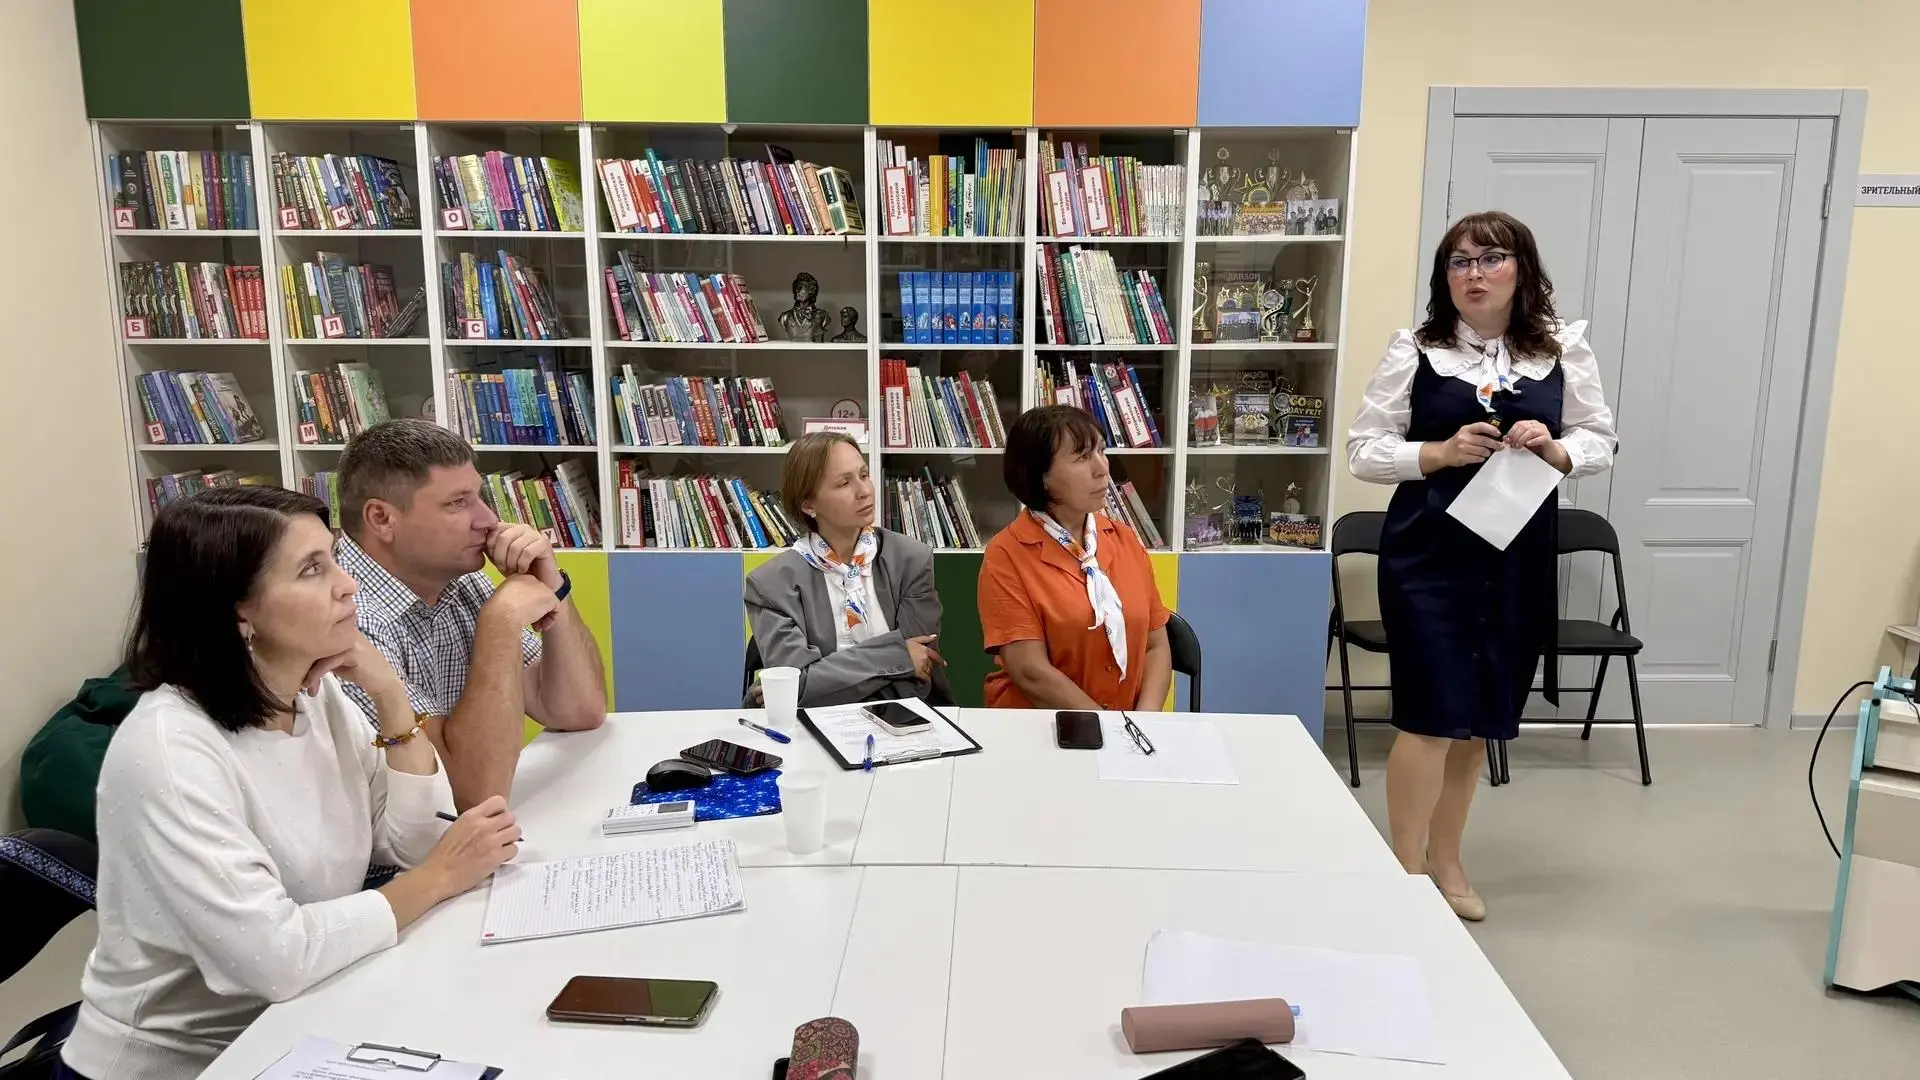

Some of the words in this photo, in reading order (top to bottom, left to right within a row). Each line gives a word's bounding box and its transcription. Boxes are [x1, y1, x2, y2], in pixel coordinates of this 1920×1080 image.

[120, 212, 130, 222] А
[286, 212, 296, 224] Д
[337, 210, 346, 221] К
[448, 212, 458, 222] О
[132, 322, 141, 332] Б
[329, 321, 339, 331] Л
[472, 323, 480, 333] С
[838, 410, 855, 418] 12+
[152, 427, 161, 436] В
[304, 427, 314, 437] М
